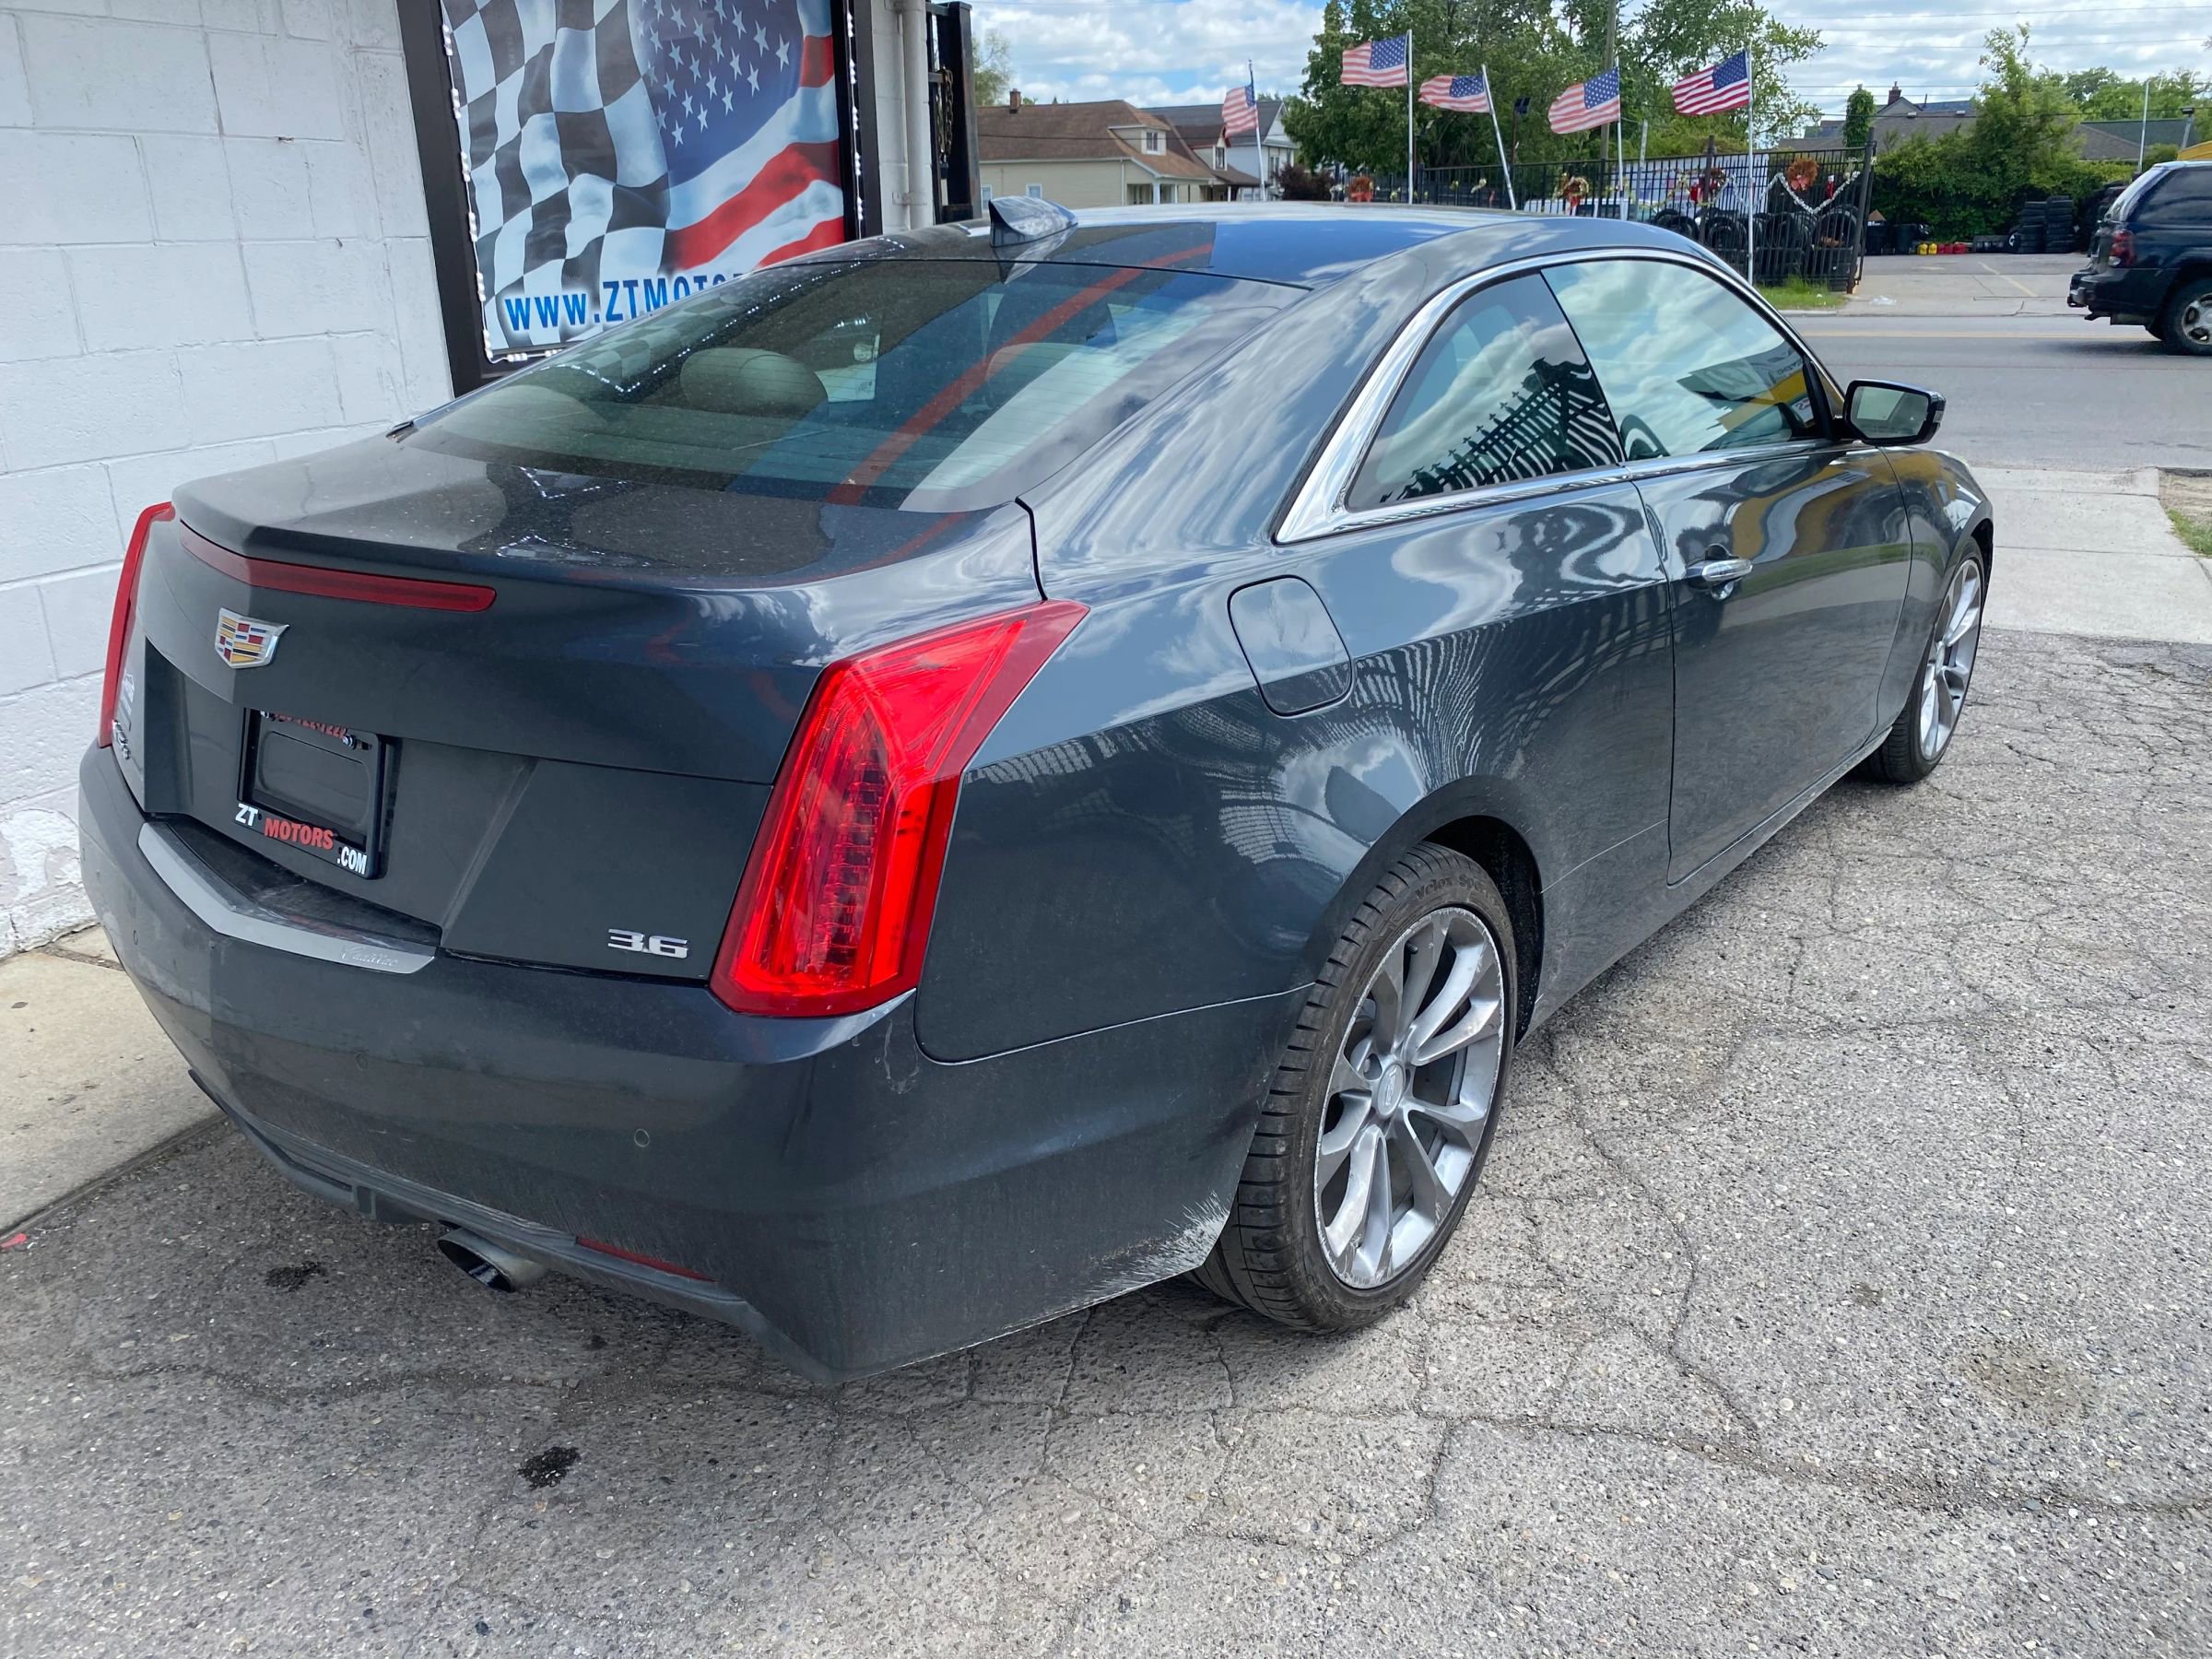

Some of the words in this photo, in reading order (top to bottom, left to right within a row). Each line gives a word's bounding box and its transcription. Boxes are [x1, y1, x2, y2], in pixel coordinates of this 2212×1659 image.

[504, 273, 744, 331] WWW.ZTMO
[235, 803, 259, 826] ZT
[264, 818, 334, 850] MOTORS
[336, 846, 367, 875] .COM
